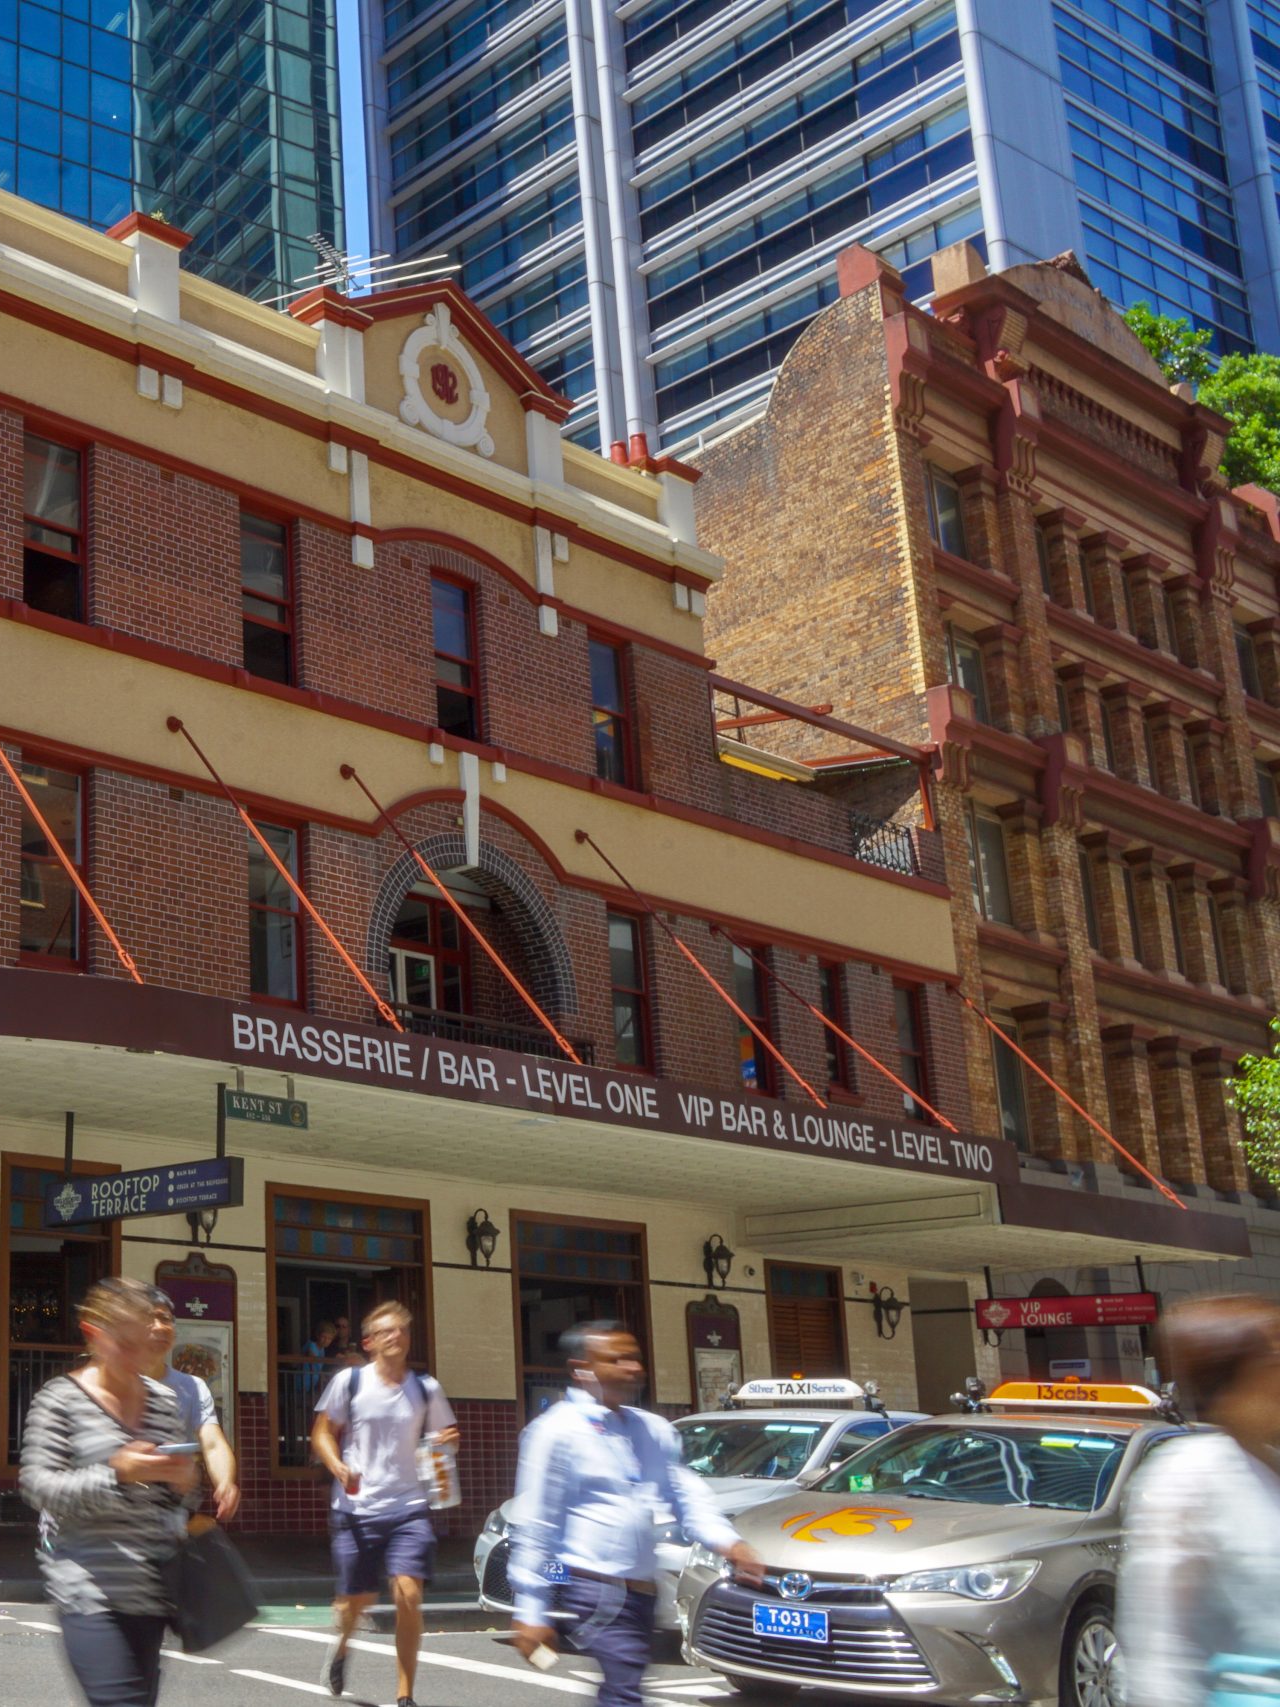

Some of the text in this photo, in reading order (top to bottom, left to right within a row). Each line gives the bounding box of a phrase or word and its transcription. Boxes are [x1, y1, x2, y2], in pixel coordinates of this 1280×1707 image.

[232, 1012, 414, 1078] BRASSERIE
[438, 1050, 500, 1092] BAR
[521, 1064, 602, 1110] LEVEL
[606, 1080, 660, 1119] ONE
[232, 1096, 283, 1115] KENT ST
[678, 1093, 714, 1127] VIP
[720, 1101, 768, 1138] BAR
[773, 1113, 788, 1140] &
[792, 1112, 876, 1154] LOUNGE
[891, 1129, 949, 1166] LEVEL
[950, 1140, 993, 1173] TWO
[91, 1174, 160, 1200] ROOFTOP
[91, 1194, 147, 1217] TERRACE
[1020, 1302, 1041, 1313] VIP
[1021, 1312, 1073, 1326] LOUNGE
[748, 1383, 846, 1394] Silver TAXI Service
[1037, 1384, 1098, 1401] 13cabs
